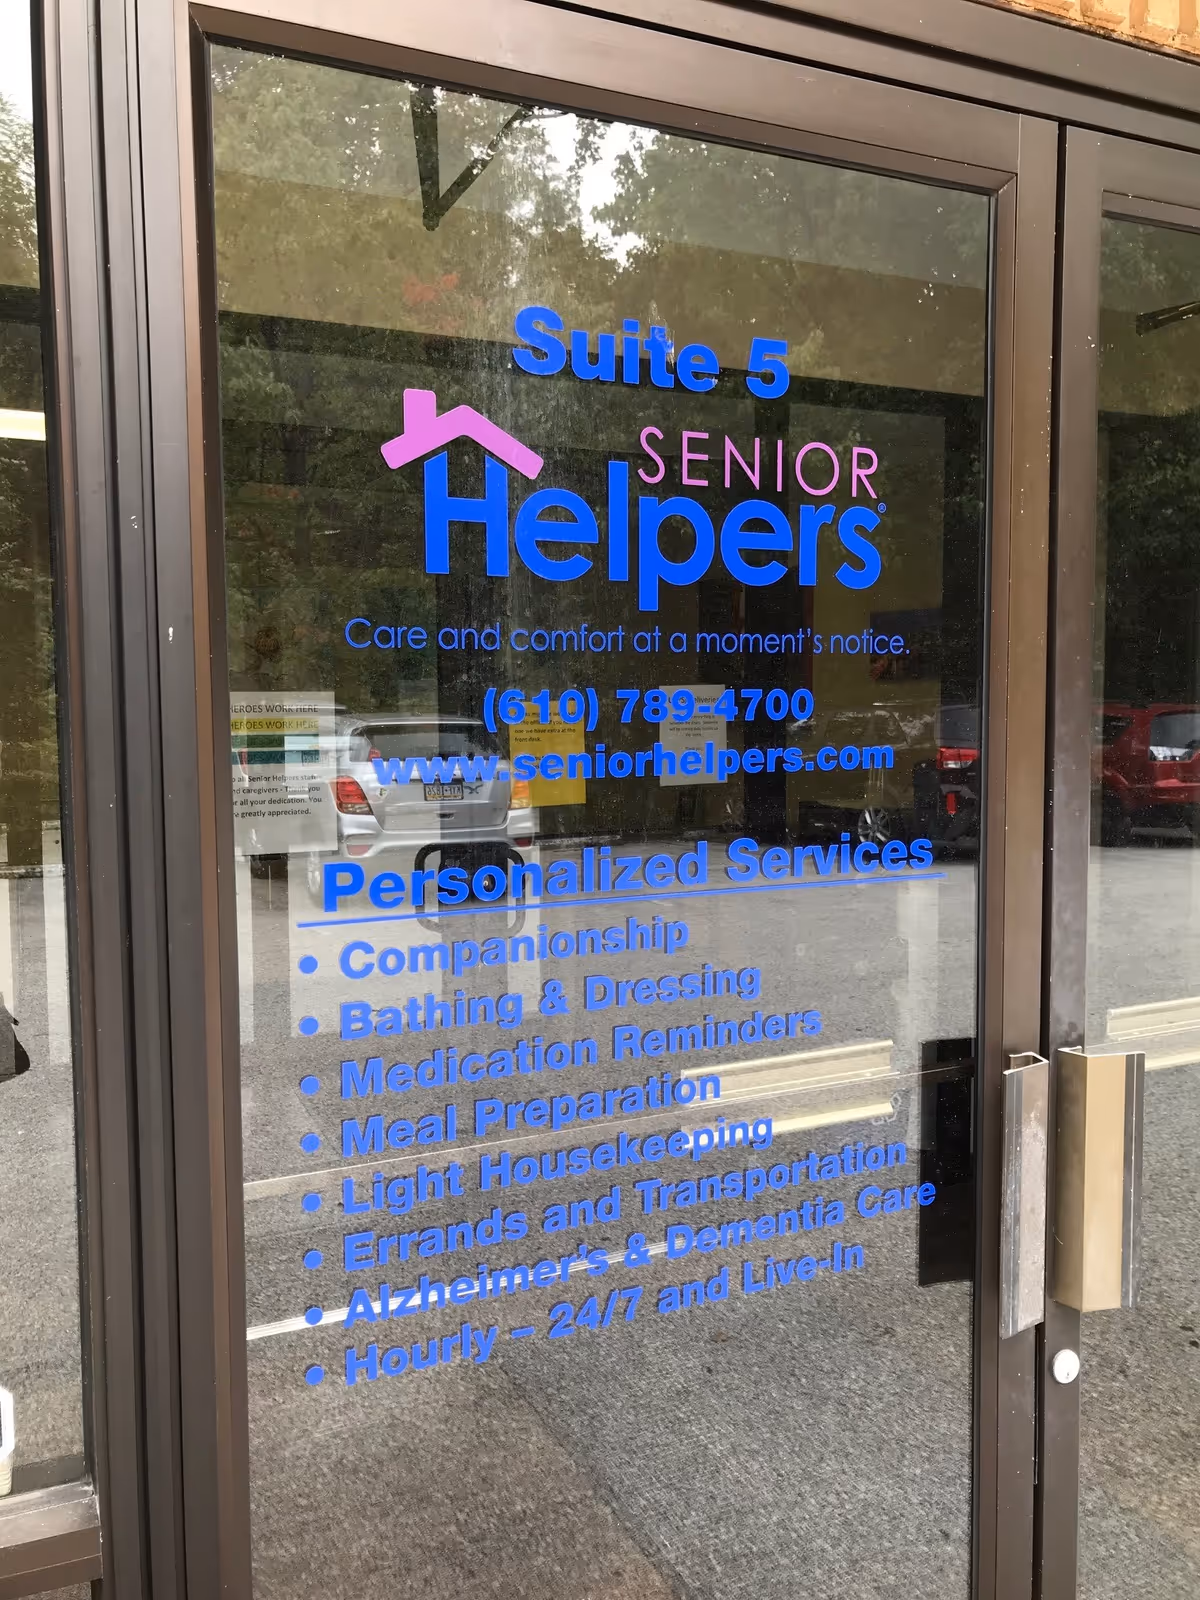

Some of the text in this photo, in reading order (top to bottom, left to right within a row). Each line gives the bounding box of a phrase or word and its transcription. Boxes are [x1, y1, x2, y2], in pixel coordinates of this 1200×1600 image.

[512, 305, 791, 400] Suite 5
[637, 426, 878, 498] SENIOR
[344, 617, 911, 655] Care and comfort at a moment's notice.
[265, 703, 294, 714] WORK
[296, 703, 319, 713] HERE
[266, 720, 295, 730] WORK
[296, 719, 319, 729] HERE
[483, 687, 815, 734] (610) 789-4700
[232, 787, 241, 795] nd
[242, 786, 279, 796] caregivers
[308, 785, 321, 795] you
[248, 775, 271, 784] Senior
[273, 774, 299, 785] Helpers
[372, 739, 895, 787] www.seniorhelpers.com
[239, 798, 249, 806] all
[249, 799, 266, 808] your
[268, 797, 307, 806] dedication.
[309, 796, 322, 804] You
[241, 809, 266, 819] greatly
[267, 808, 312, 818] appreciated.
[322, 832, 935, 914] Personalized Services
[339, 914, 690, 980] Companionship
[340, 965, 762, 1041] Bathing & Dressing
[341, 1007, 823, 1100] Medication Reminders
[341, 1071, 722, 1158] Meal Preparation
[342, 1114, 774, 1216] Light Housekeeping
[344, 1140, 907, 1272] Errands and Transportation
[343, 1182, 937, 1329] Alzheimer's & Dementia Care
[345, 1322, 498, 1386] Hourly
[549, 1286, 644, 1340] 24/7
[657, 1266, 730, 1314] and
[743, 1240, 864, 1295] Live-In
